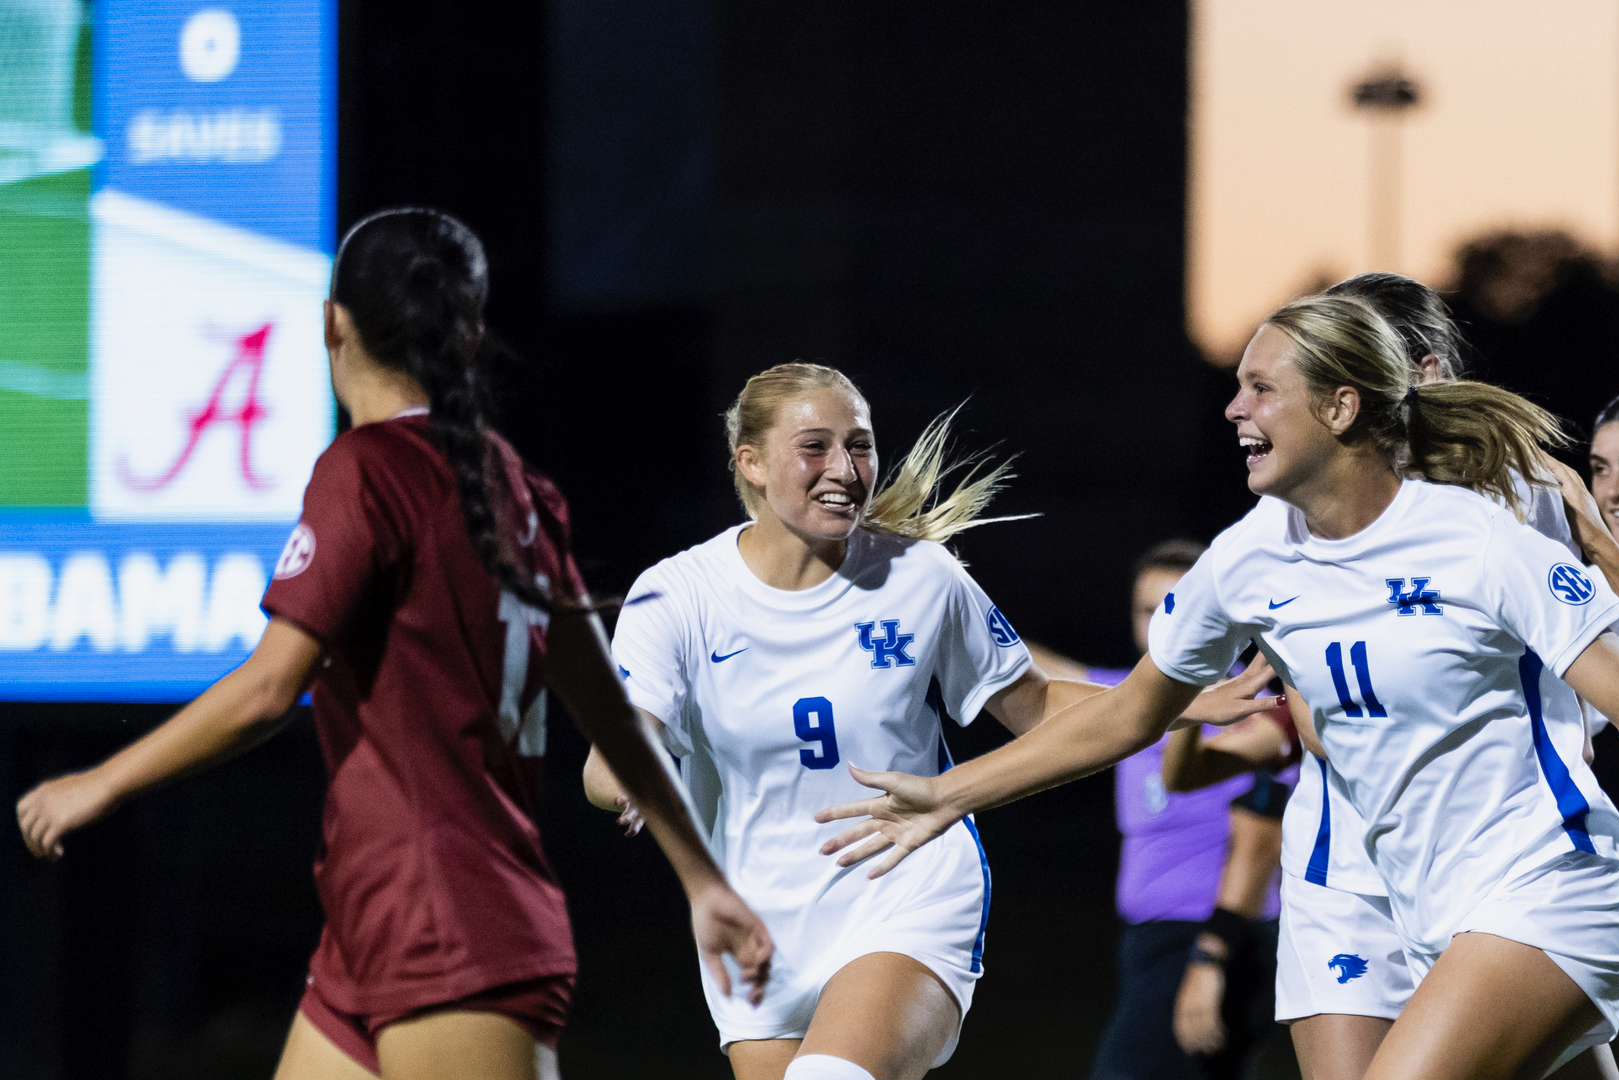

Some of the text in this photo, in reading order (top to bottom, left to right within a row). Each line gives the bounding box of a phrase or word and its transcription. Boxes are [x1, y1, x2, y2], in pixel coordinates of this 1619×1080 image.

[179, 8, 241, 83] 0
[1551, 565, 1592, 602] SEC
[854, 619, 915, 669] UK
[1325, 641, 1388, 718] 11
[793, 696, 840, 770] 9
